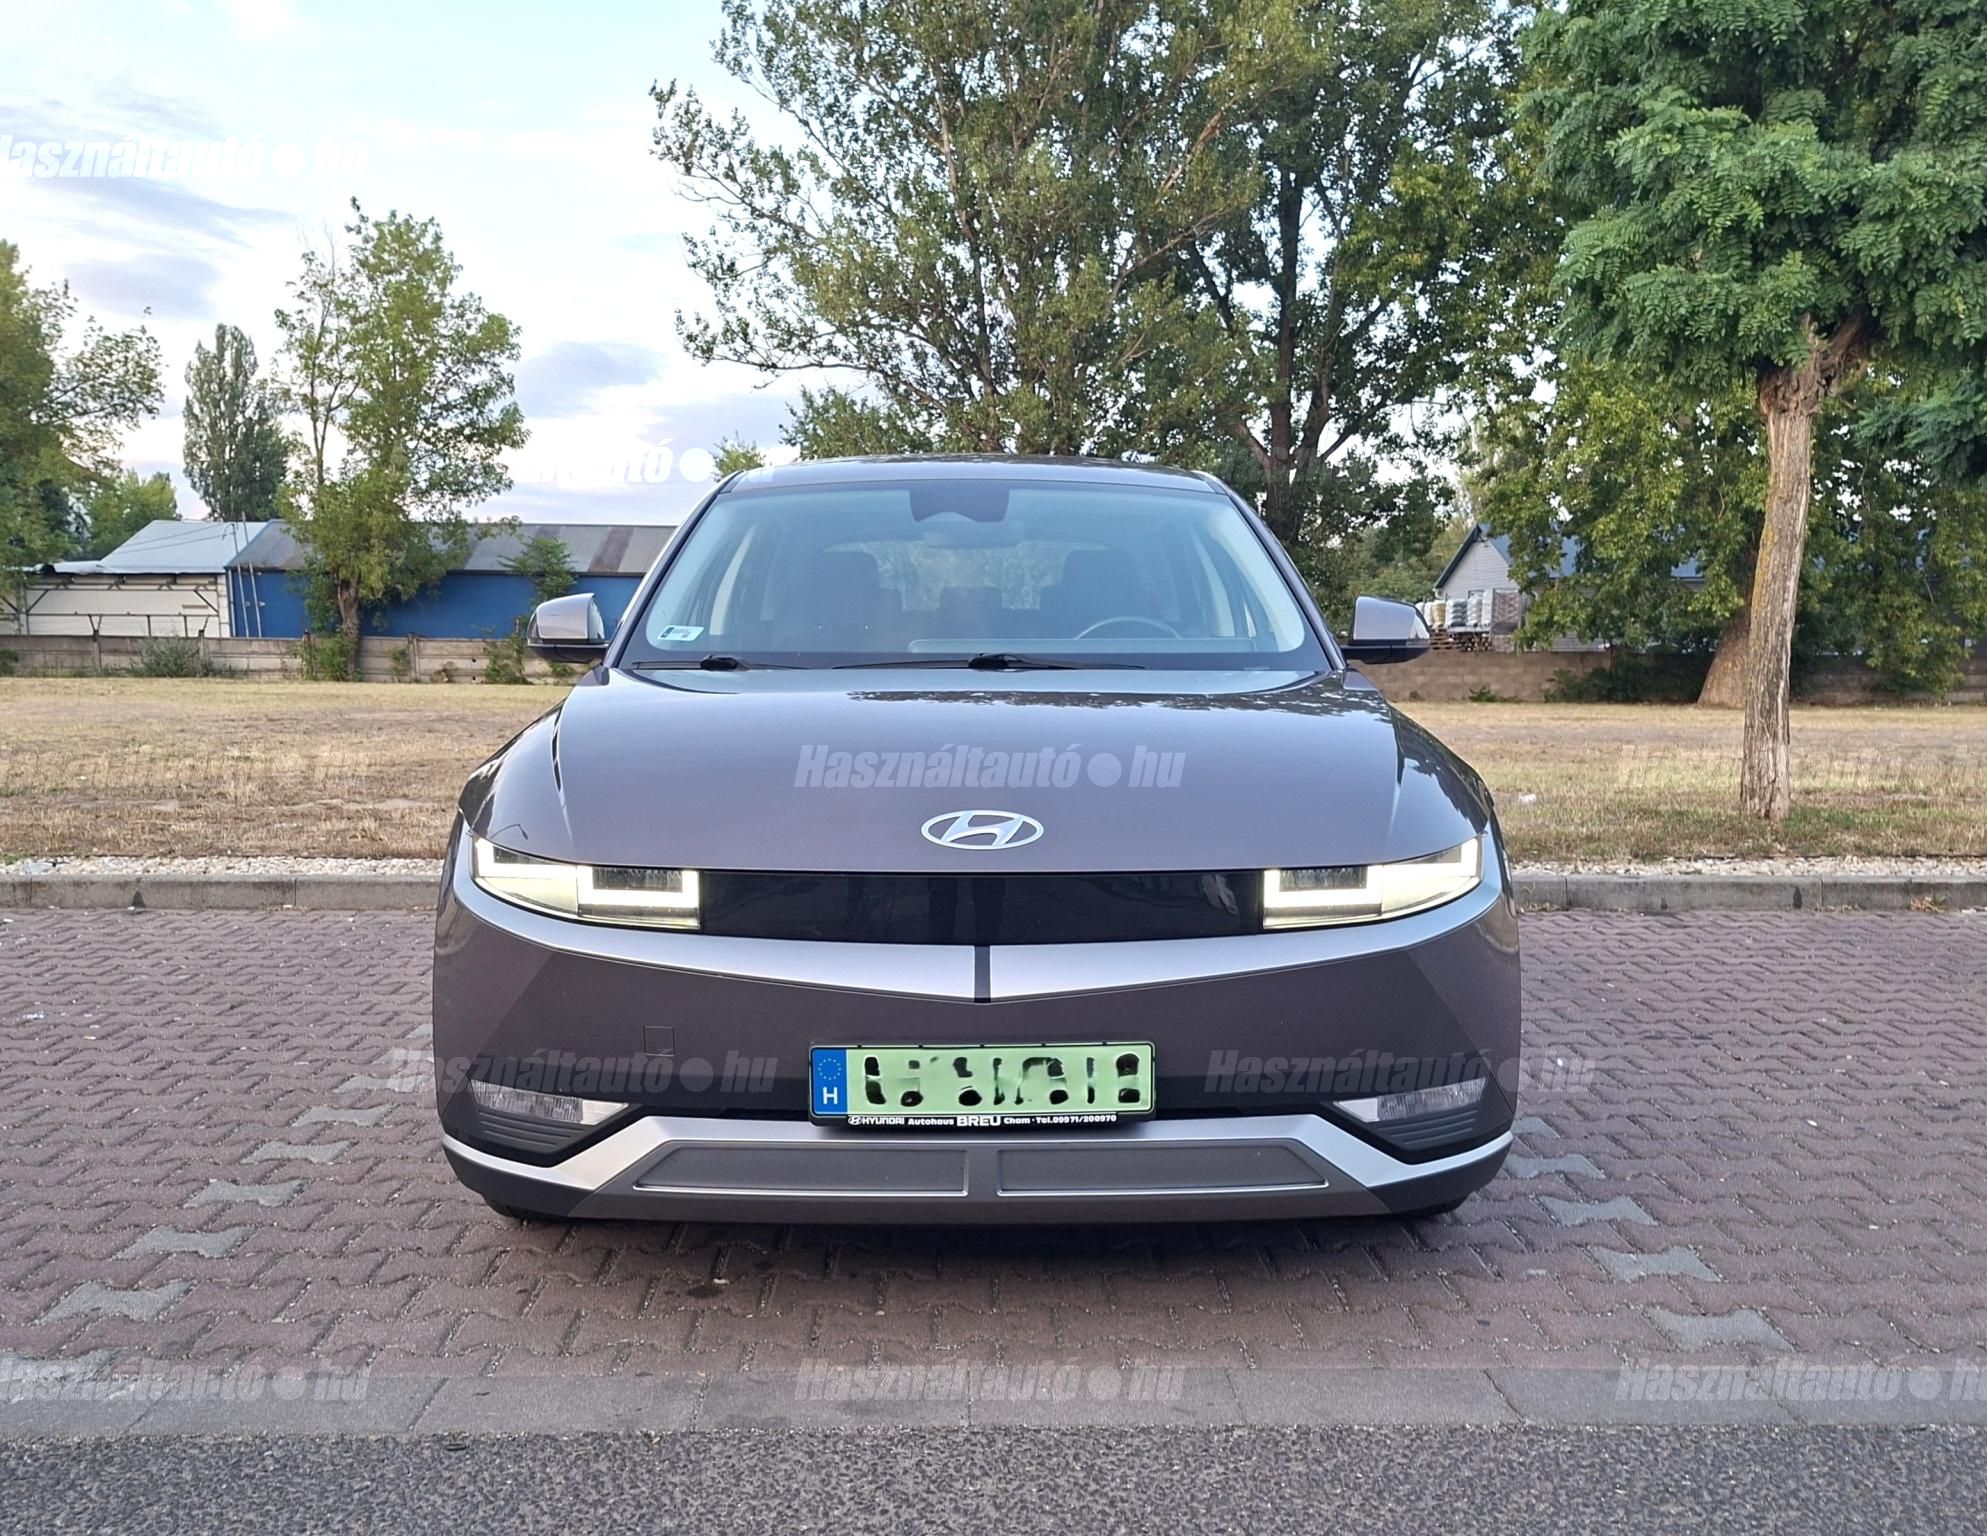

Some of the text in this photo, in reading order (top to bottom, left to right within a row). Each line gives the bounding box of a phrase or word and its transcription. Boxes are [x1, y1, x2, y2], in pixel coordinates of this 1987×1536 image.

[823, 1087, 838, 1105] H
[862, 1116, 905, 1125] HYUNDAI
[907, 1117, 955, 1126] Autohaus
[956, 1115, 1001, 1127] BREU
